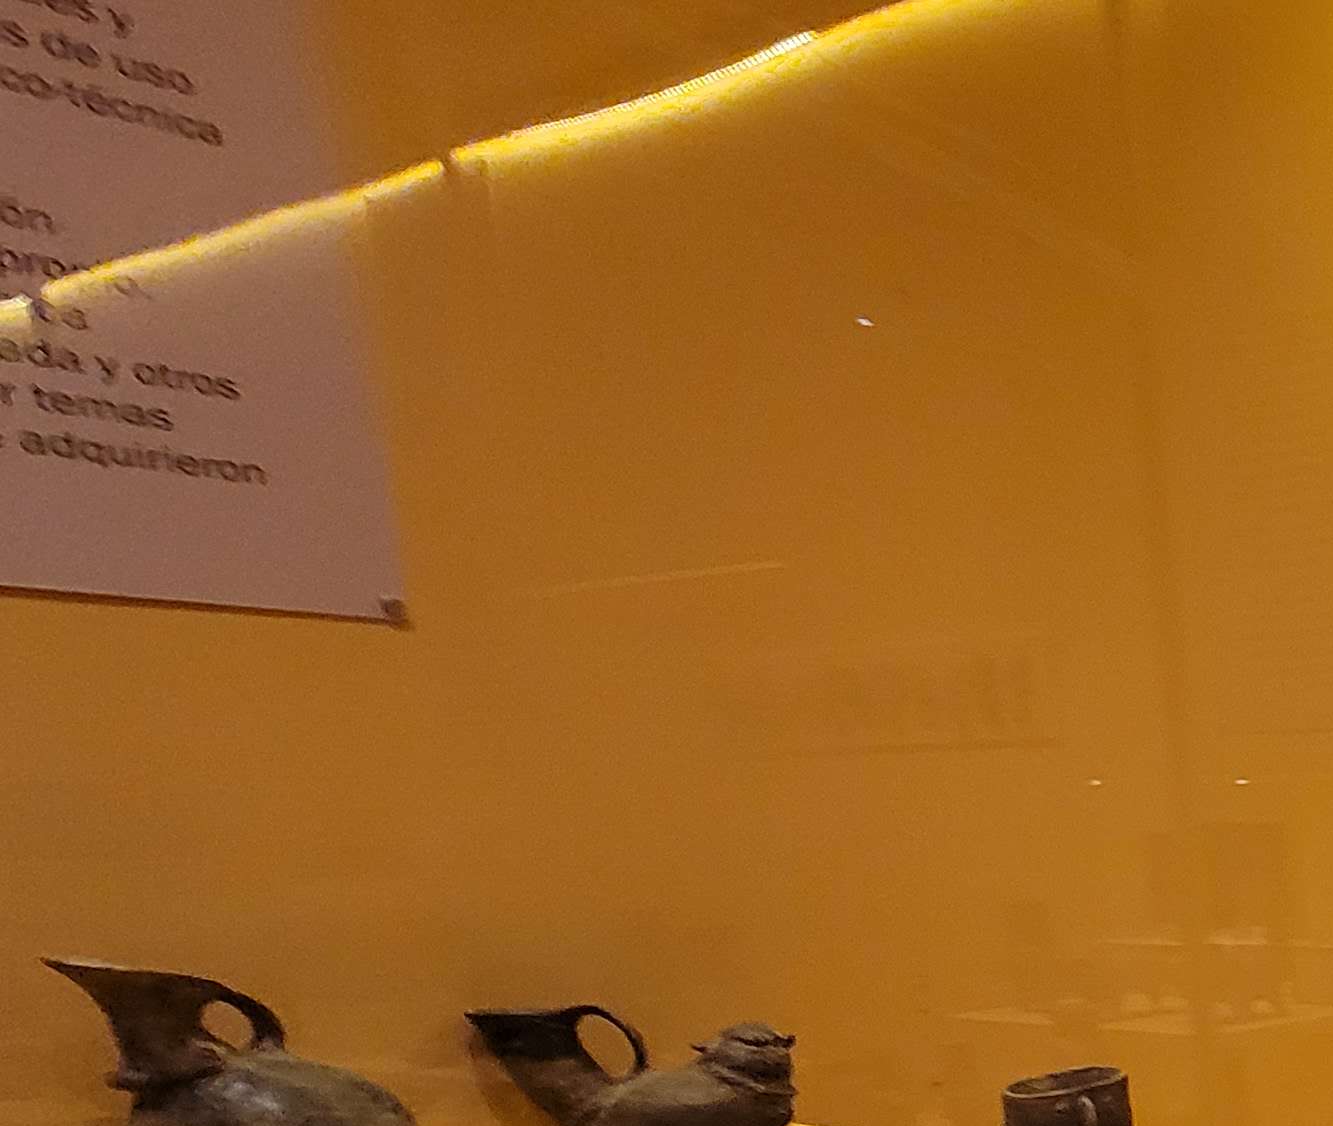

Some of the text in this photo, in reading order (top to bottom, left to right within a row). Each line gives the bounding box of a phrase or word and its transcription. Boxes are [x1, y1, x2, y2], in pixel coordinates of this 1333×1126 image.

[40, 30, 102, 69] de
[110, 52, 198, 97] uso
[30, 381, 175, 433] temas
[131, 360, 242, 402] otros
[18, 427, 269, 487] adquirieron
